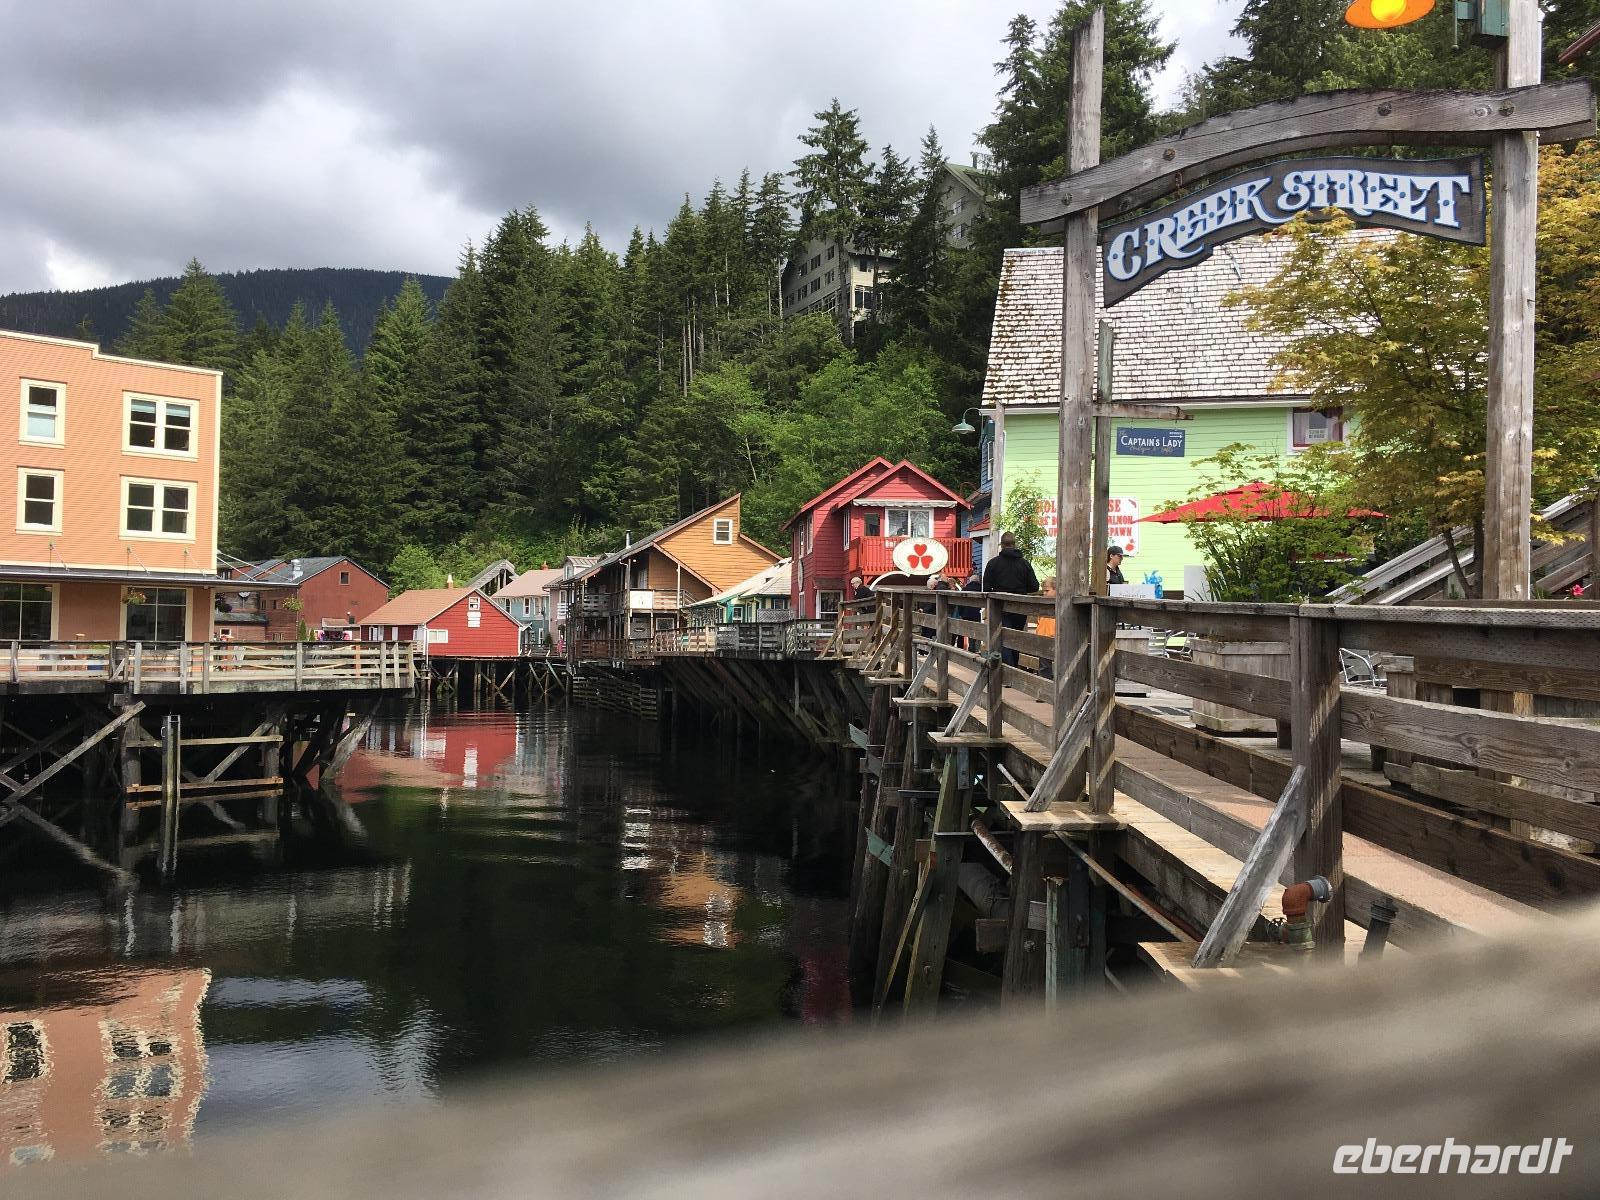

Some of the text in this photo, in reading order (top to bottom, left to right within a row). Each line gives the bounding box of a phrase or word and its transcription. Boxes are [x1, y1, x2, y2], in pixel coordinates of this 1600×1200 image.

[1107, 169, 1470, 281] CREEK STREET
[1120, 435, 1183, 447] CAPTAIN'S LADY
[1107, 515, 1133, 525] ALMON
[1107, 527, 1132, 537] PAWN
